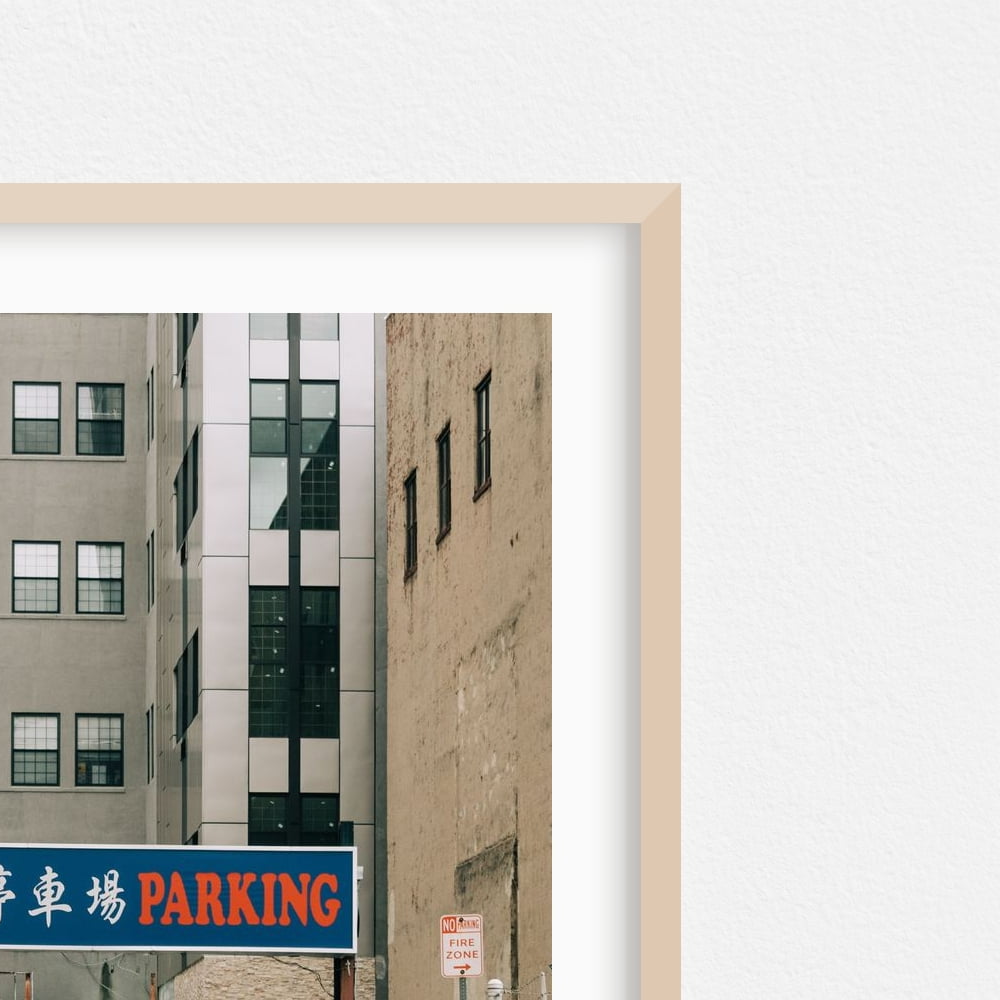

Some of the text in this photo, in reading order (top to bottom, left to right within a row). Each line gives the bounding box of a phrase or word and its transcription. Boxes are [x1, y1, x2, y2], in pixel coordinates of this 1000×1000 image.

[138, 871, 341, 927] PARKING
[443, 919, 456, 932] NO
[449, 938, 474, 947] FIRE
[446, 950, 479, 959] ZONE
